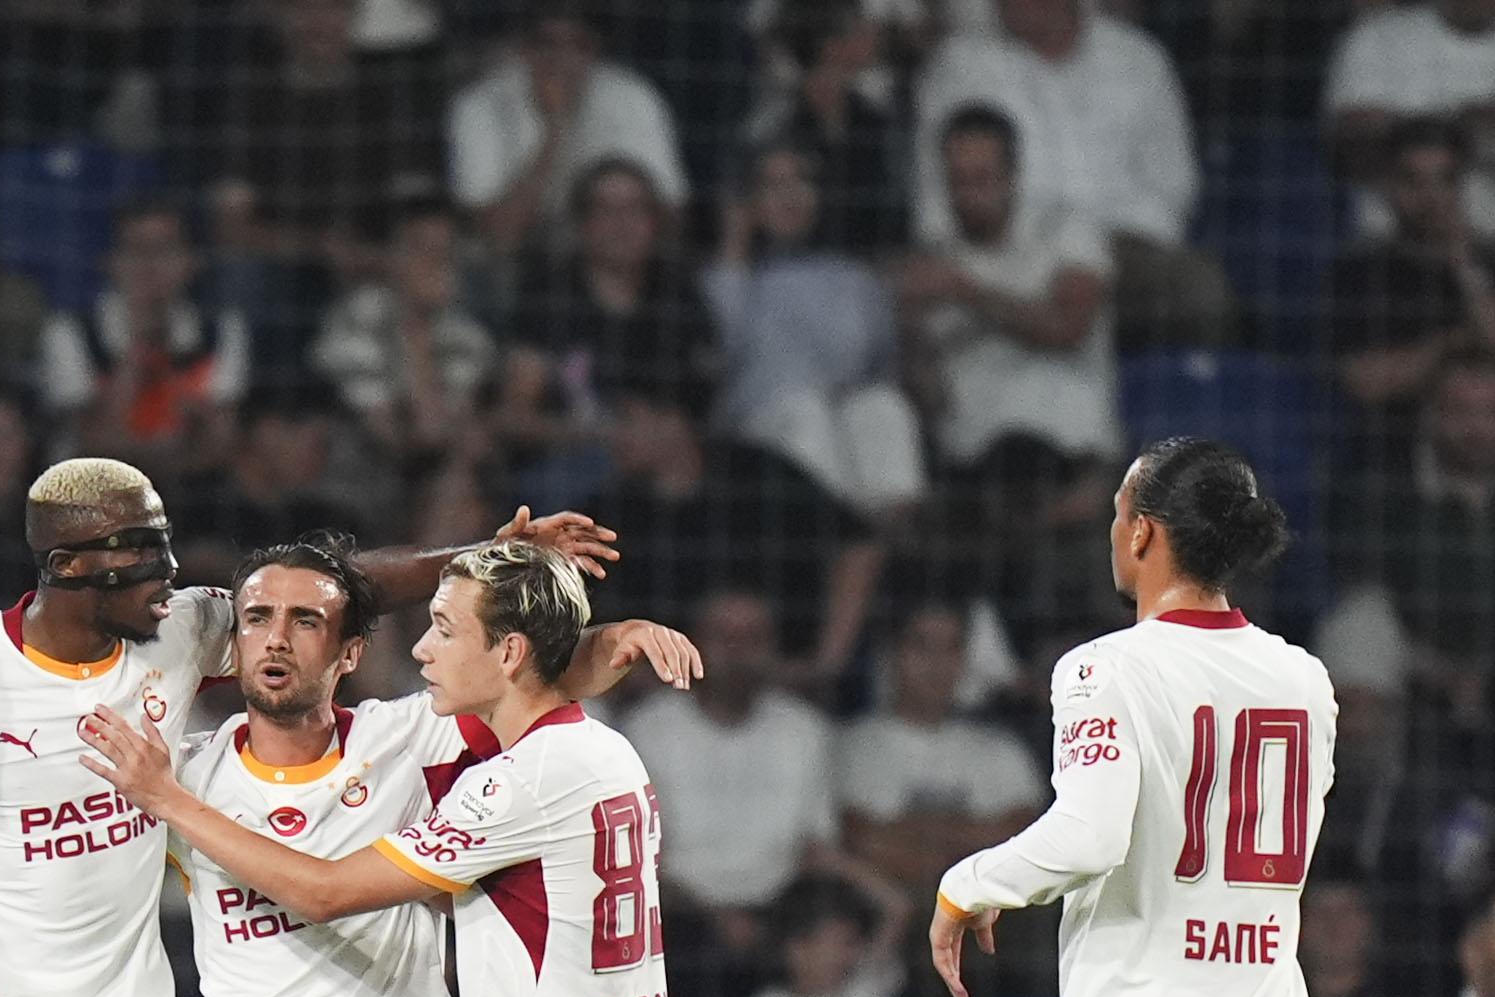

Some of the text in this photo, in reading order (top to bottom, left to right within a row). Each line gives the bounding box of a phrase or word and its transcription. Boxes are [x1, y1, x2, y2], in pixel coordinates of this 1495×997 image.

[20, 789, 134, 834] PASi
[1175, 705, 1309, 884] 10
[24, 811, 161, 862] HOLDiN
[224, 911, 306, 944] HOL
[1184, 914, 1281, 964] SANÉ
